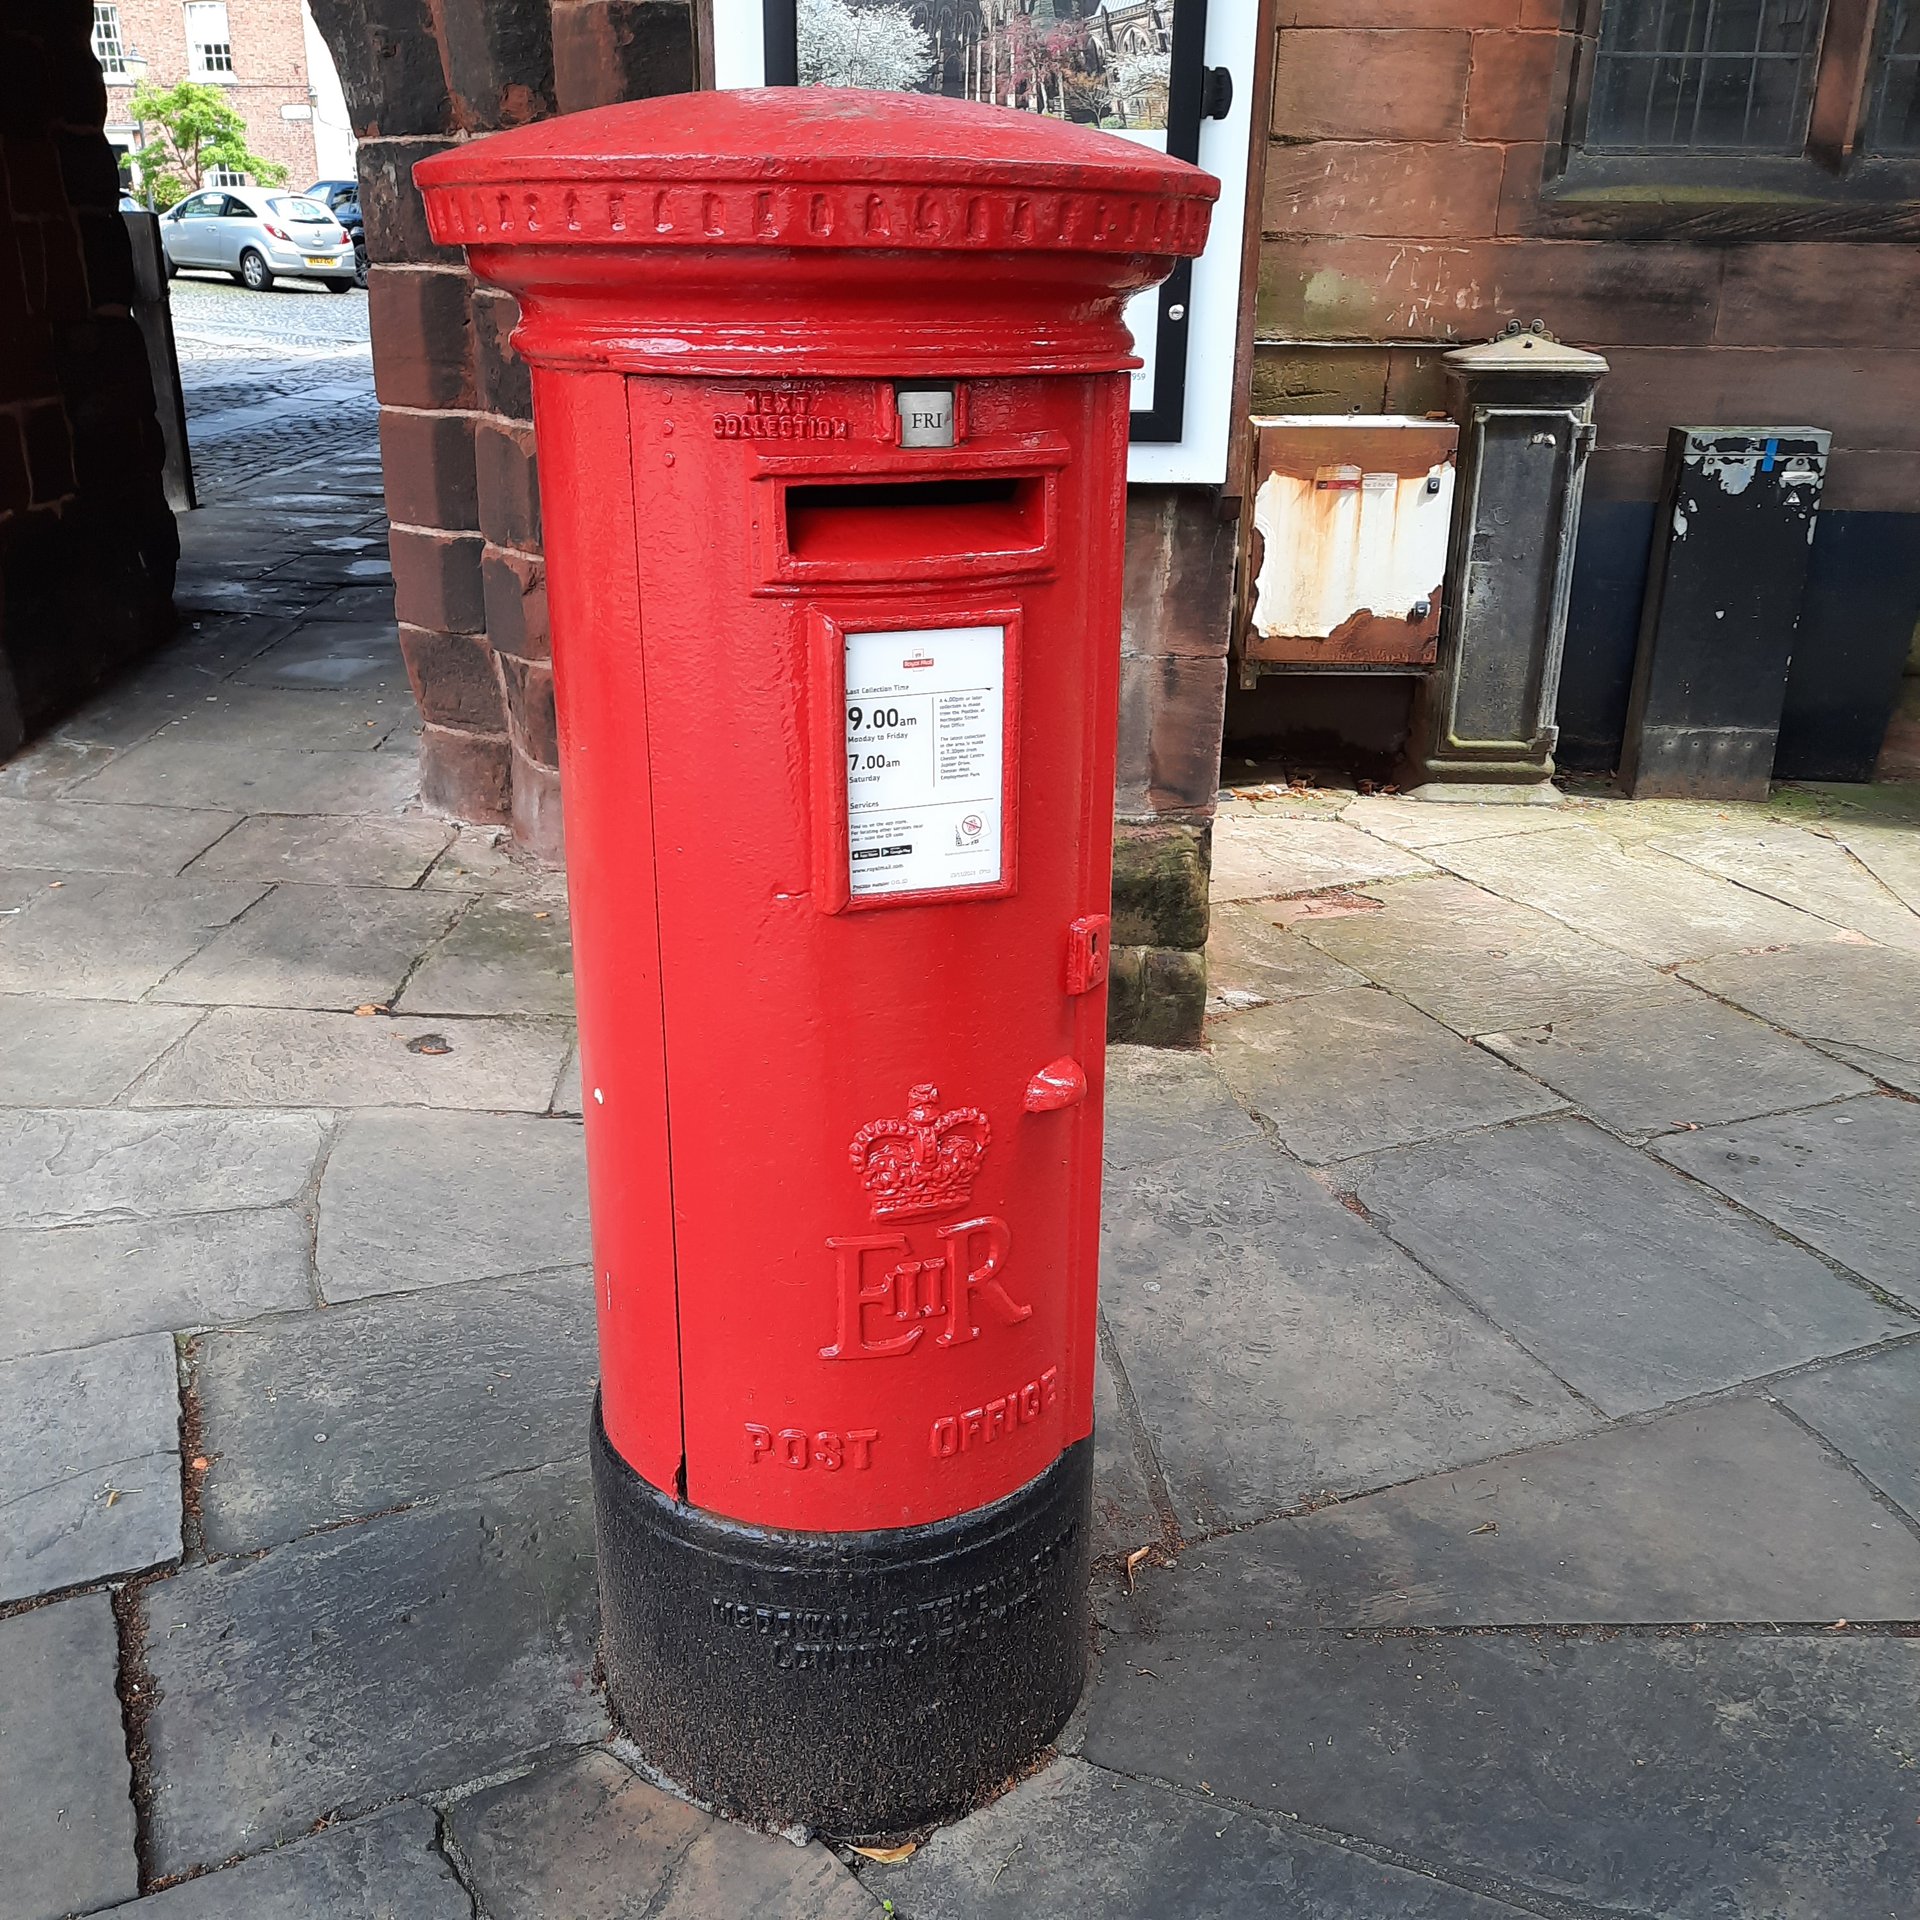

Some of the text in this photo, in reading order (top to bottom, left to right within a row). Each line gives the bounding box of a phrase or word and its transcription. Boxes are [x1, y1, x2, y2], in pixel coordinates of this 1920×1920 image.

[744, 389, 810, 415] NEXT
[713, 413, 849, 440] COLLECTION
[911, 412, 942, 430] FRI
[845, 688, 860, 696] Last
[861, 685, 893, 694] Collection
[847, 706, 917, 731] 9.00am
[847, 735, 876, 743] Monday
[886, 731, 909, 740] Friday
[848, 753, 901, 771] 7.00am
[849, 774, 881, 784] Saturday
[849, 801, 880, 810] Services
[744, 1365, 1060, 1471] POST OFFICE
